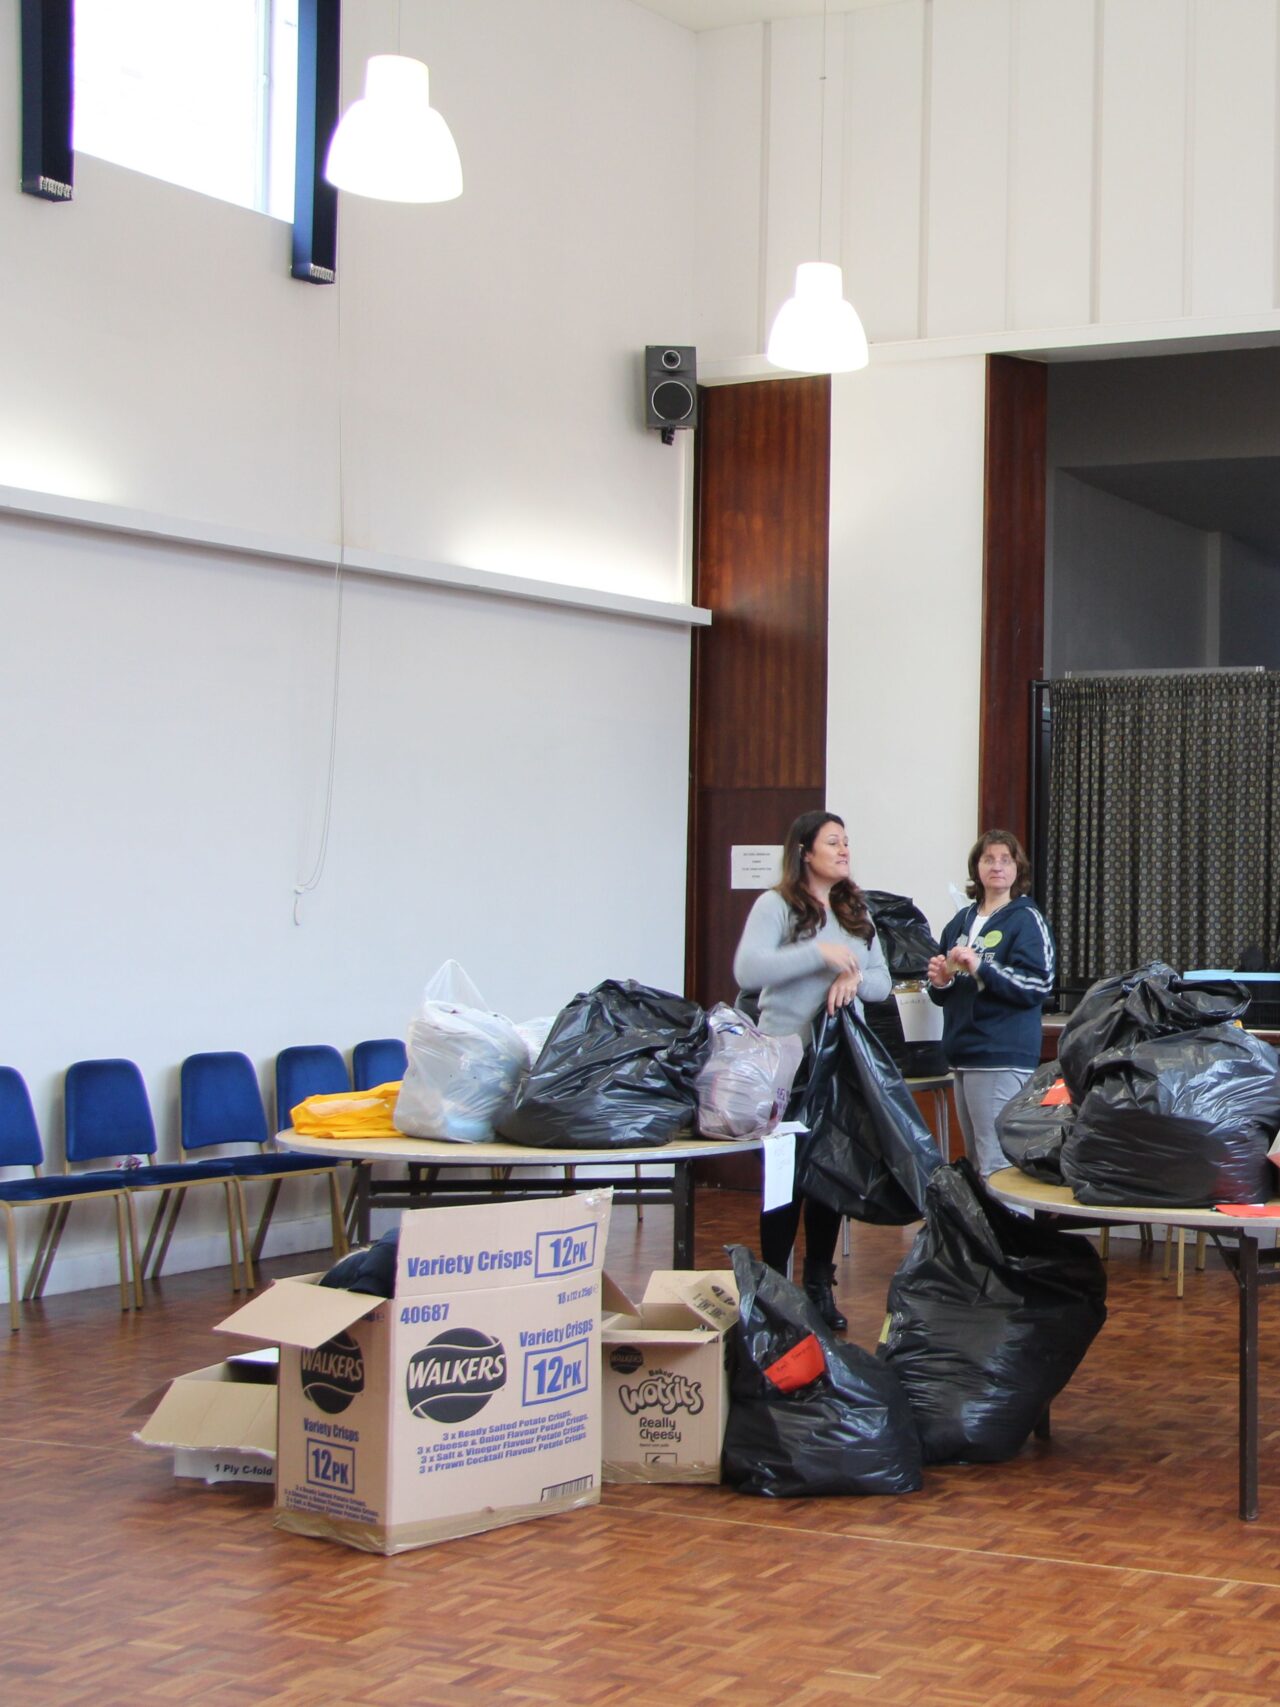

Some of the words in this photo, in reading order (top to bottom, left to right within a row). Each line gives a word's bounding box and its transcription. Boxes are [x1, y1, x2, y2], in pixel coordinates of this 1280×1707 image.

[407, 1254, 474, 1278] Variety
[477, 1249, 533, 1272] Crisps
[549, 1236, 587, 1268] 12PK
[400, 1303, 450, 1324] 40687
[519, 1328, 565, 1348] Variety
[565, 1318, 594, 1339] Crisps
[302, 1348, 363, 1382] WALKERS
[408, 1354, 505, 1390] WALKERS
[533, 1356, 582, 1395] 12PK
[304, 1418, 332, 1437] Variety
[332, 1424, 360, 1442] Crisps
[640, 1416, 676, 1430] Really
[640, 1428, 682, 1442] Cheesy
[223, 1464, 239, 1475] Ply
[243, 1465, 273, 1475] C-fold
[312, 1448, 349, 1485] 12PK
